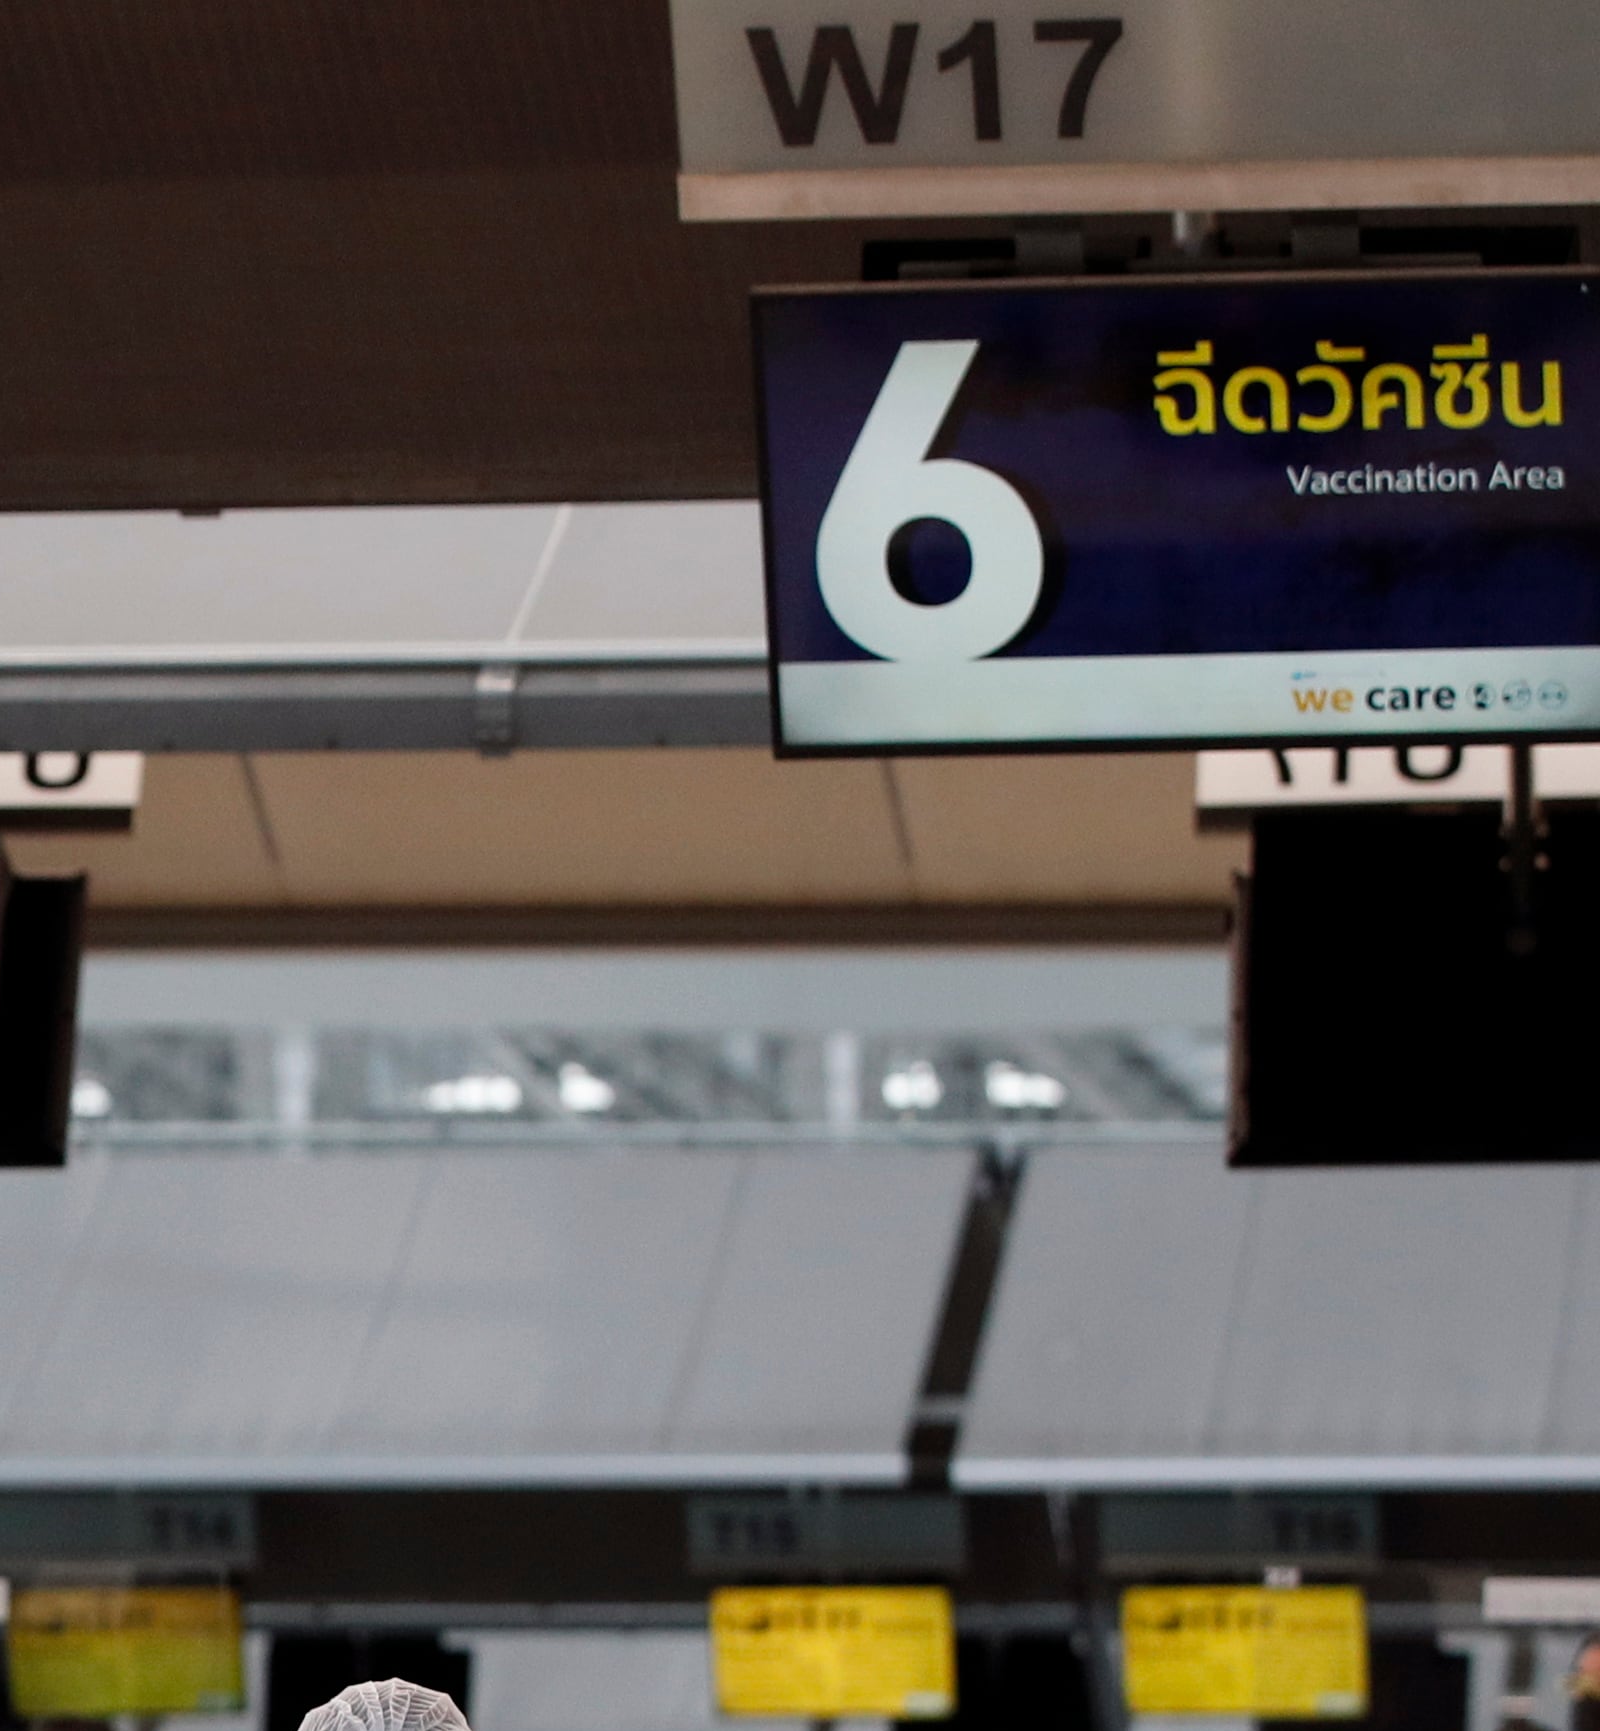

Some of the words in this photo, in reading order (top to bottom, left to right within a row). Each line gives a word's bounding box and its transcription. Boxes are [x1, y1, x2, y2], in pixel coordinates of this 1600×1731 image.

[746, 19, 1123, 147] W17
[1152, 334, 1564, 436] ฉีดวัคซีน
[816, 339, 1044, 664] 6
[1286, 462, 1479, 496] Vaccination
[1490, 461, 1565, 492] Area
[1292, 684, 1355, 714] we
[1365, 680, 1458, 712] care
